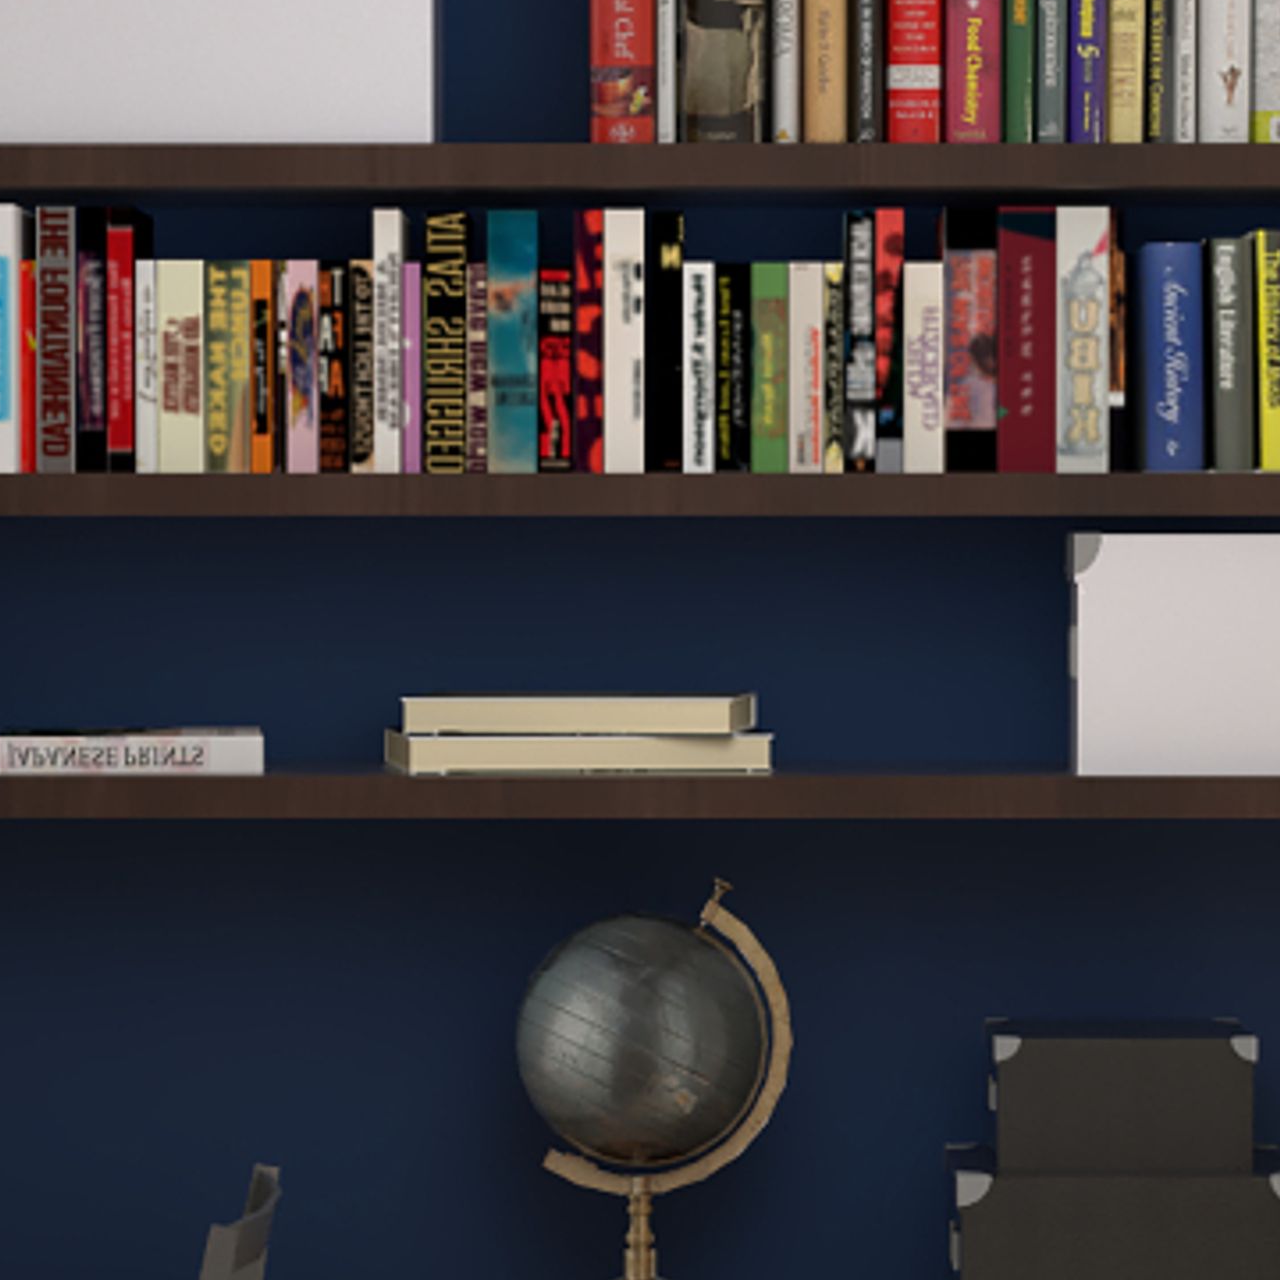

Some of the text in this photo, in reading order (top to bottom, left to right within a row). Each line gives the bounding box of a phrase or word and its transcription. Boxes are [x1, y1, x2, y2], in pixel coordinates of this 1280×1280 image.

[613, 18, 637, 60] Chef
[962, 18, 982, 124] Food Chemistry
[1215, 244, 1237, 390] English Literature
[1155, 347, 1189, 426] History
